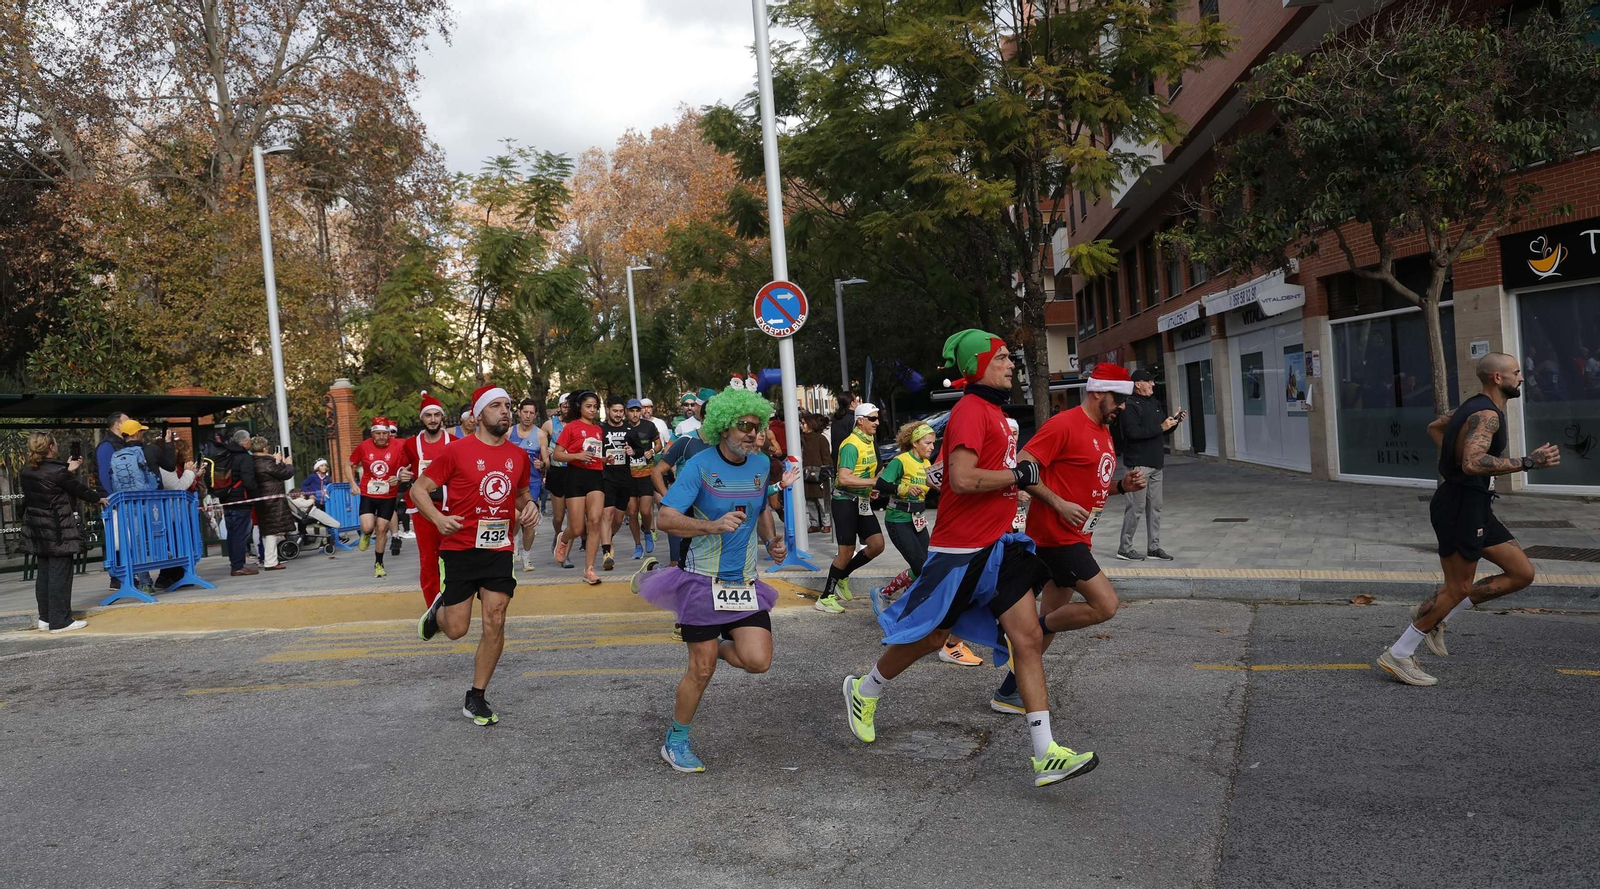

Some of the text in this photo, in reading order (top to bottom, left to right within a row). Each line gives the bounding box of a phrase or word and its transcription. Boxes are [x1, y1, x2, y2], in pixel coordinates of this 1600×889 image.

[1261, 294, 1301, 303] VITALDENT
[757, 314, 806, 336] EXCEPTO BUS
[1385, 440, 1408, 448] ROYAL
[1377, 450, 1419, 465] BLISS
[480, 530, 506, 542] 432
[717, 589, 752, 602] 444
